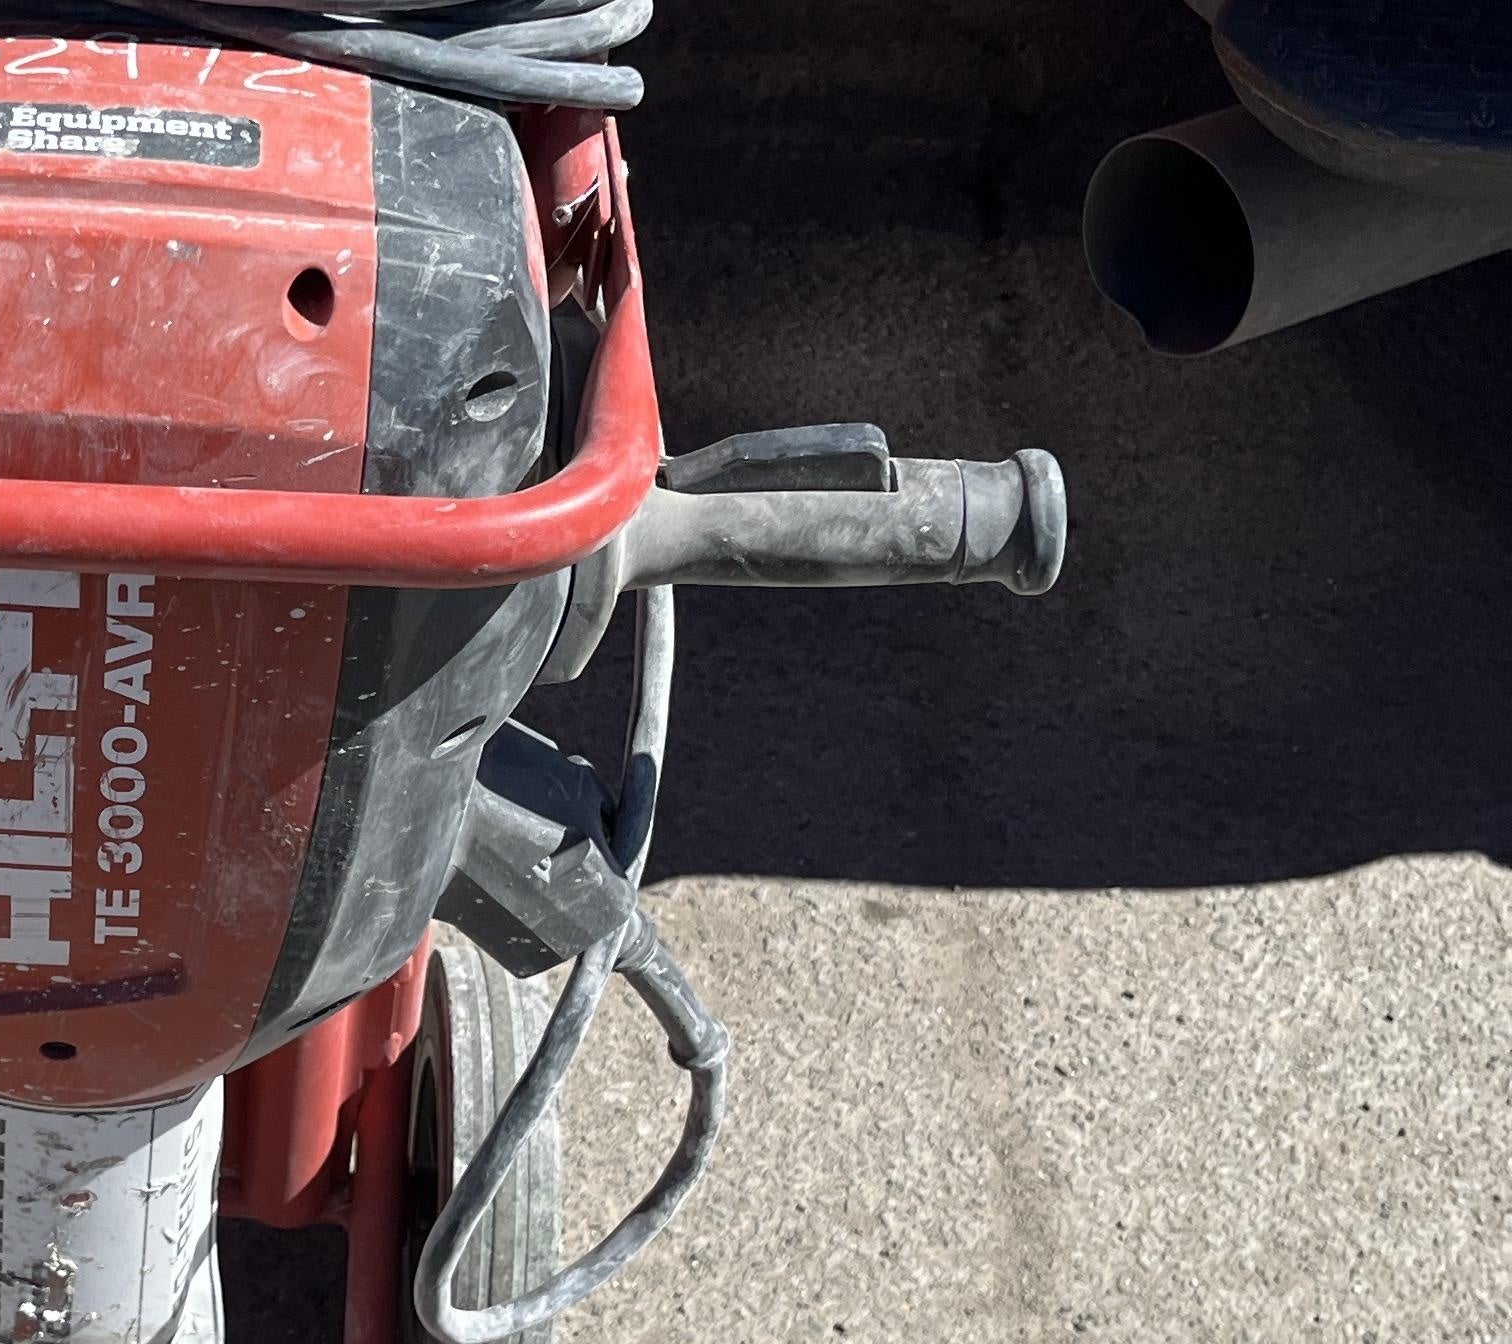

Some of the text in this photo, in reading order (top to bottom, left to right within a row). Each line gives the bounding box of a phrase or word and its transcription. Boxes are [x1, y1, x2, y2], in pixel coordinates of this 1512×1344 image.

[9, 106, 232, 141] Equipment
[94, 573, 156, 944] TE 3000-AVR
